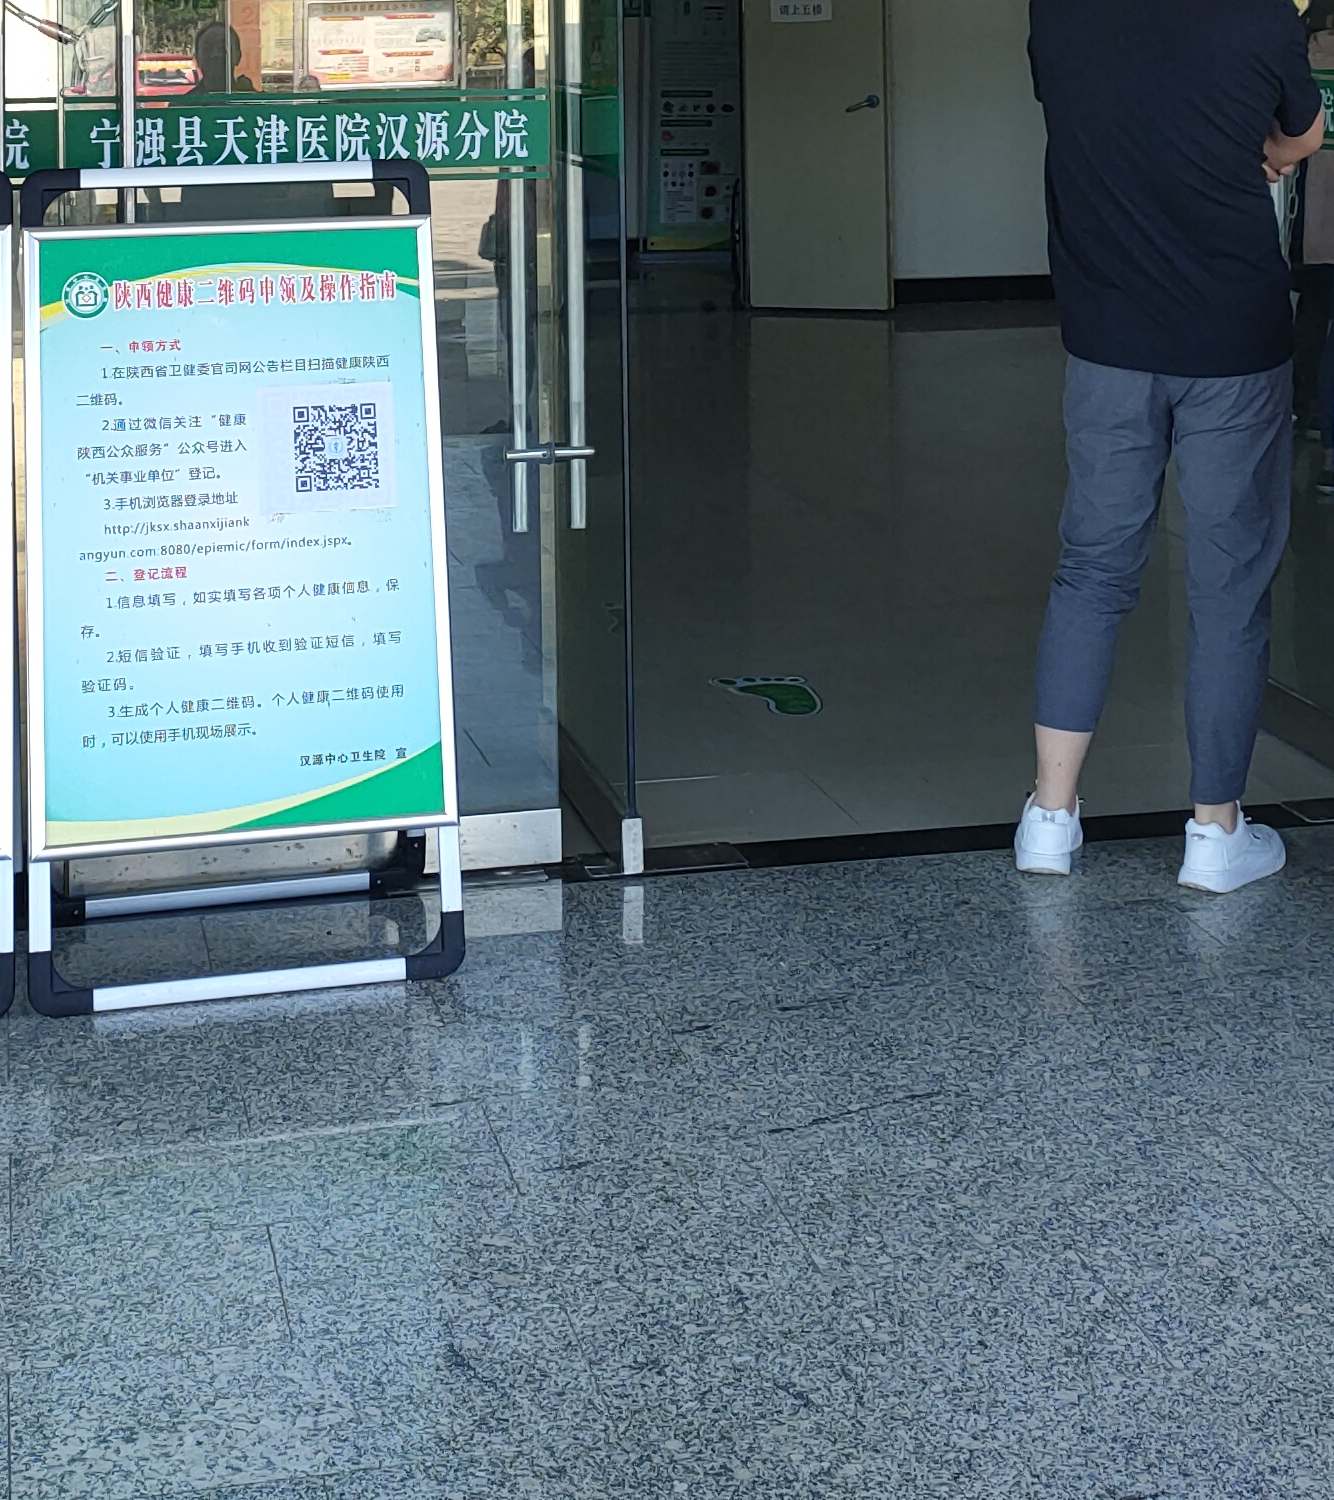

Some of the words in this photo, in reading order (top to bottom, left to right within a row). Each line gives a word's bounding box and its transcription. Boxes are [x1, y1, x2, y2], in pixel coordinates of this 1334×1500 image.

[90, 107, 529, 169] 宁强县天津医院汉源分院
[113, 271, 398, 312] 陕西健康二维码申领及操作指南
[300, 748, 386, 767] 汉源中心卫生院
